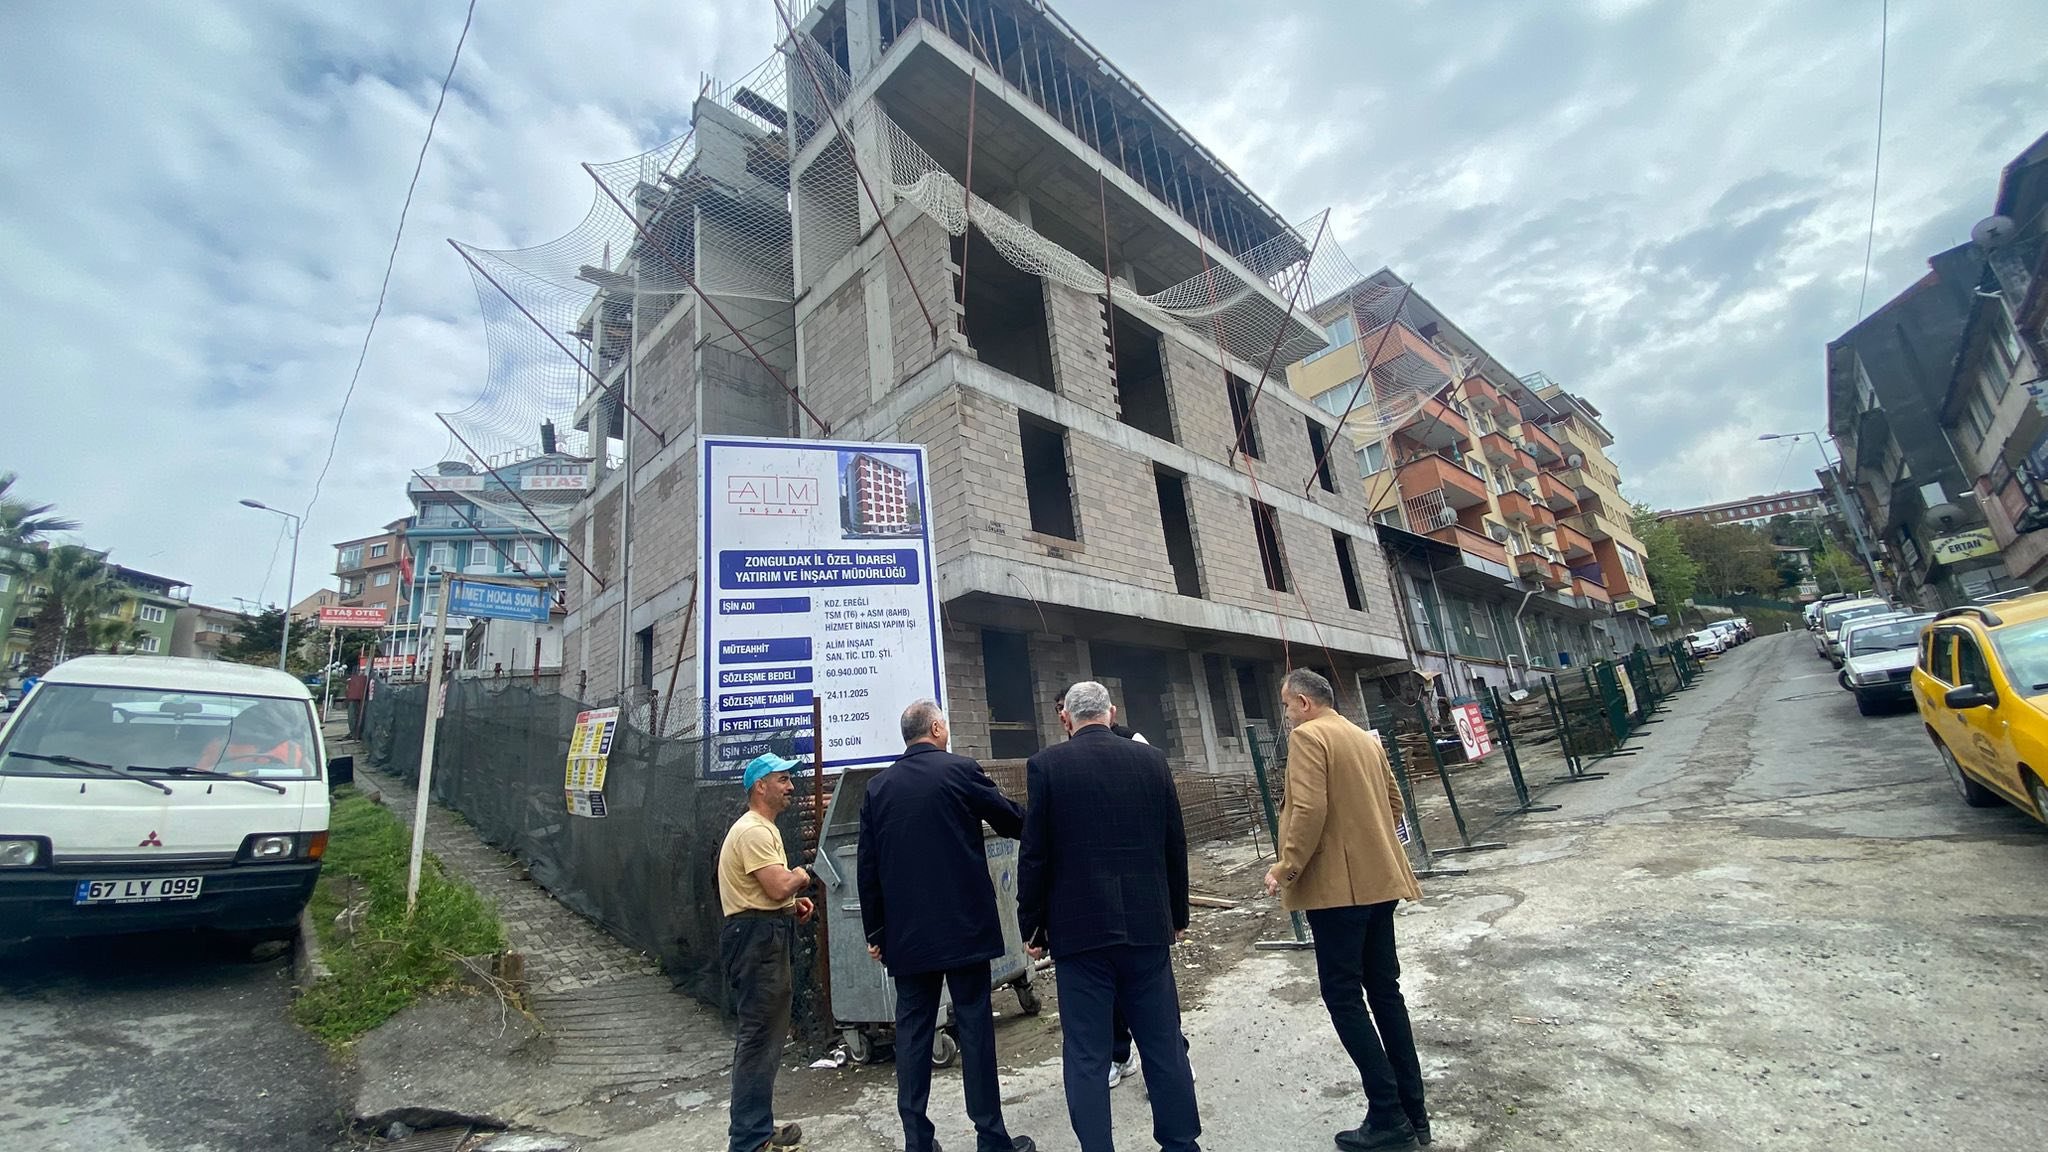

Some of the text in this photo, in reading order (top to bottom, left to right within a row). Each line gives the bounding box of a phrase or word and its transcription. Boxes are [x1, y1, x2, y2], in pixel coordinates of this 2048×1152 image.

[1948, 539, 1982, 554] ERTAN
[745, 553, 896, 567] ZONGULDAK İL ÖZEL İDARESİ
[735, 566, 906, 583] YATIRIM VE İNŞAAT MÜDÜRLÜĞÜ
[486, 590, 513, 605] HOCA
[824, 597, 869, 608] KDZ. EREĞLİ
[326, 609, 352, 617] ETAŞ
[722, 601, 755, 613] İŞİN ADI
[825, 611, 841, 620] TSM
[843, 610, 858, 620] (T6)
[867, 609, 884, 618] ASM
[825, 619, 916, 632] HİZMET BİNASI YAPIM İŞİ
[722, 644, 770, 655] MÜTEAHHİT
[826, 639, 874, 650] ALİM İNŞAAT
[826, 648, 893, 662] SAN. TİC. LTD. ŞTİ.
[722, 668, 796, 685] SÖZLEŞME BEDELİ
[826, 665, 878, 678] 60.940.000 TL
[722, 692, 795, 708] SÖZLEŞME TARİHİ
[827, 688, 869, 700] 24.11.2025
[733, 718, 752, 730] YERİ
[753, 716, 783, 729] TESLİM
[784, 714, 811, 727] TARİHİ
[828, 712, 870, 724] 19.12.2025
[828, 736, 862, 748] 350 GÜN
[722, 744, 740, 759] İŞİN
[89, 878, 199, 898] 67 LY 099
